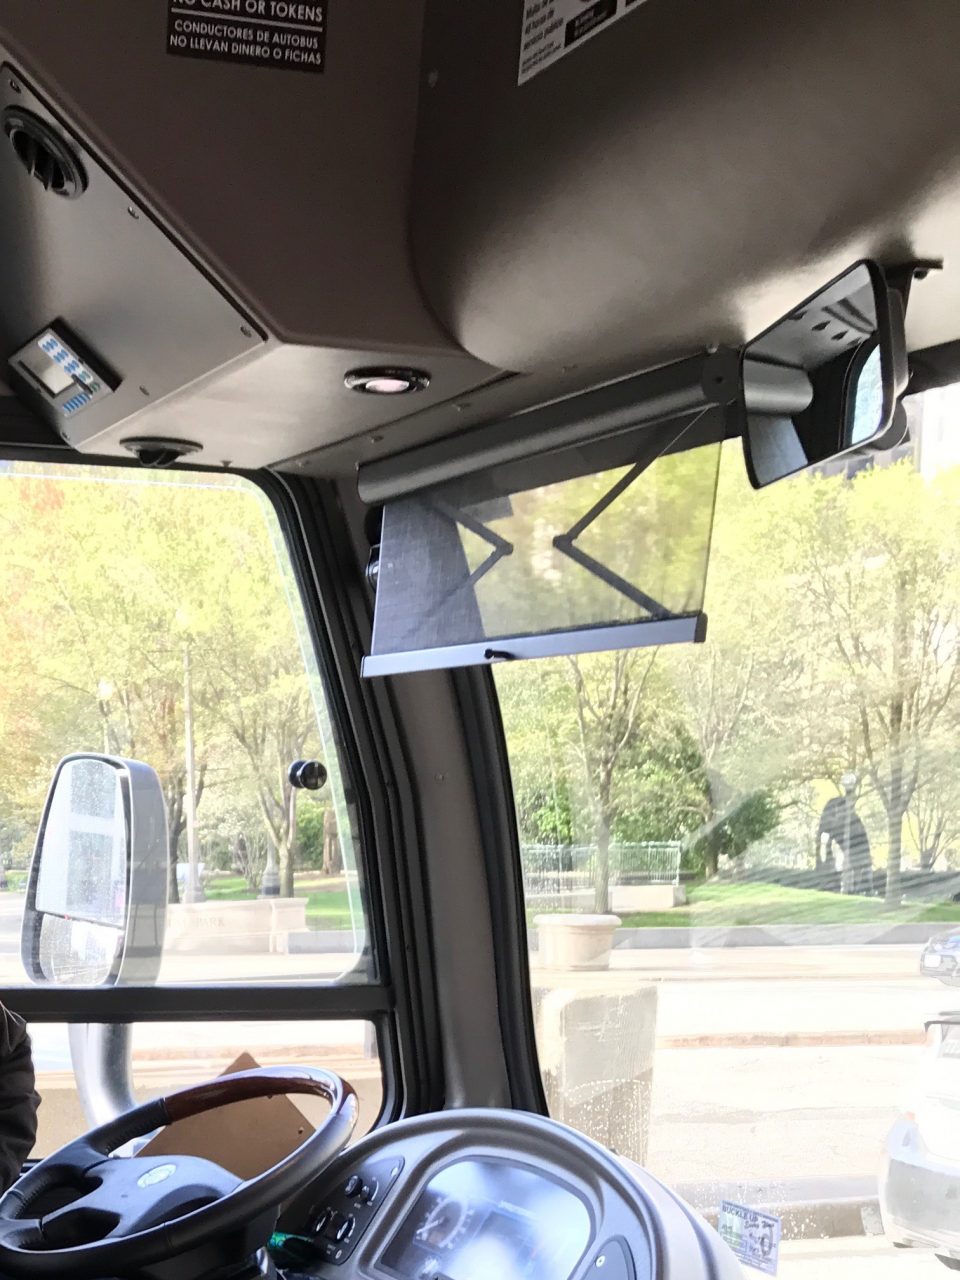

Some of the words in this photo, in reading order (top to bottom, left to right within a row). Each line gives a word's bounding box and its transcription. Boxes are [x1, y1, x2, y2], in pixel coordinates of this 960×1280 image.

[245, 0, 265, 16] OR
[270, 1, 323, 22] TOKENS
[174, 19, 253, 41] CONDUCTORES
[257, 30, 270, 43] DE
[272, 32, 318, 49] AUTOBUS
[170, 34, 187, 47] NO
[190, 38, 229, 53] LLEVAN
[231, 42, 270, 58] DINERO
[273, 48, 282, 59] O
[285, 49, 321, 65] FICHAS
